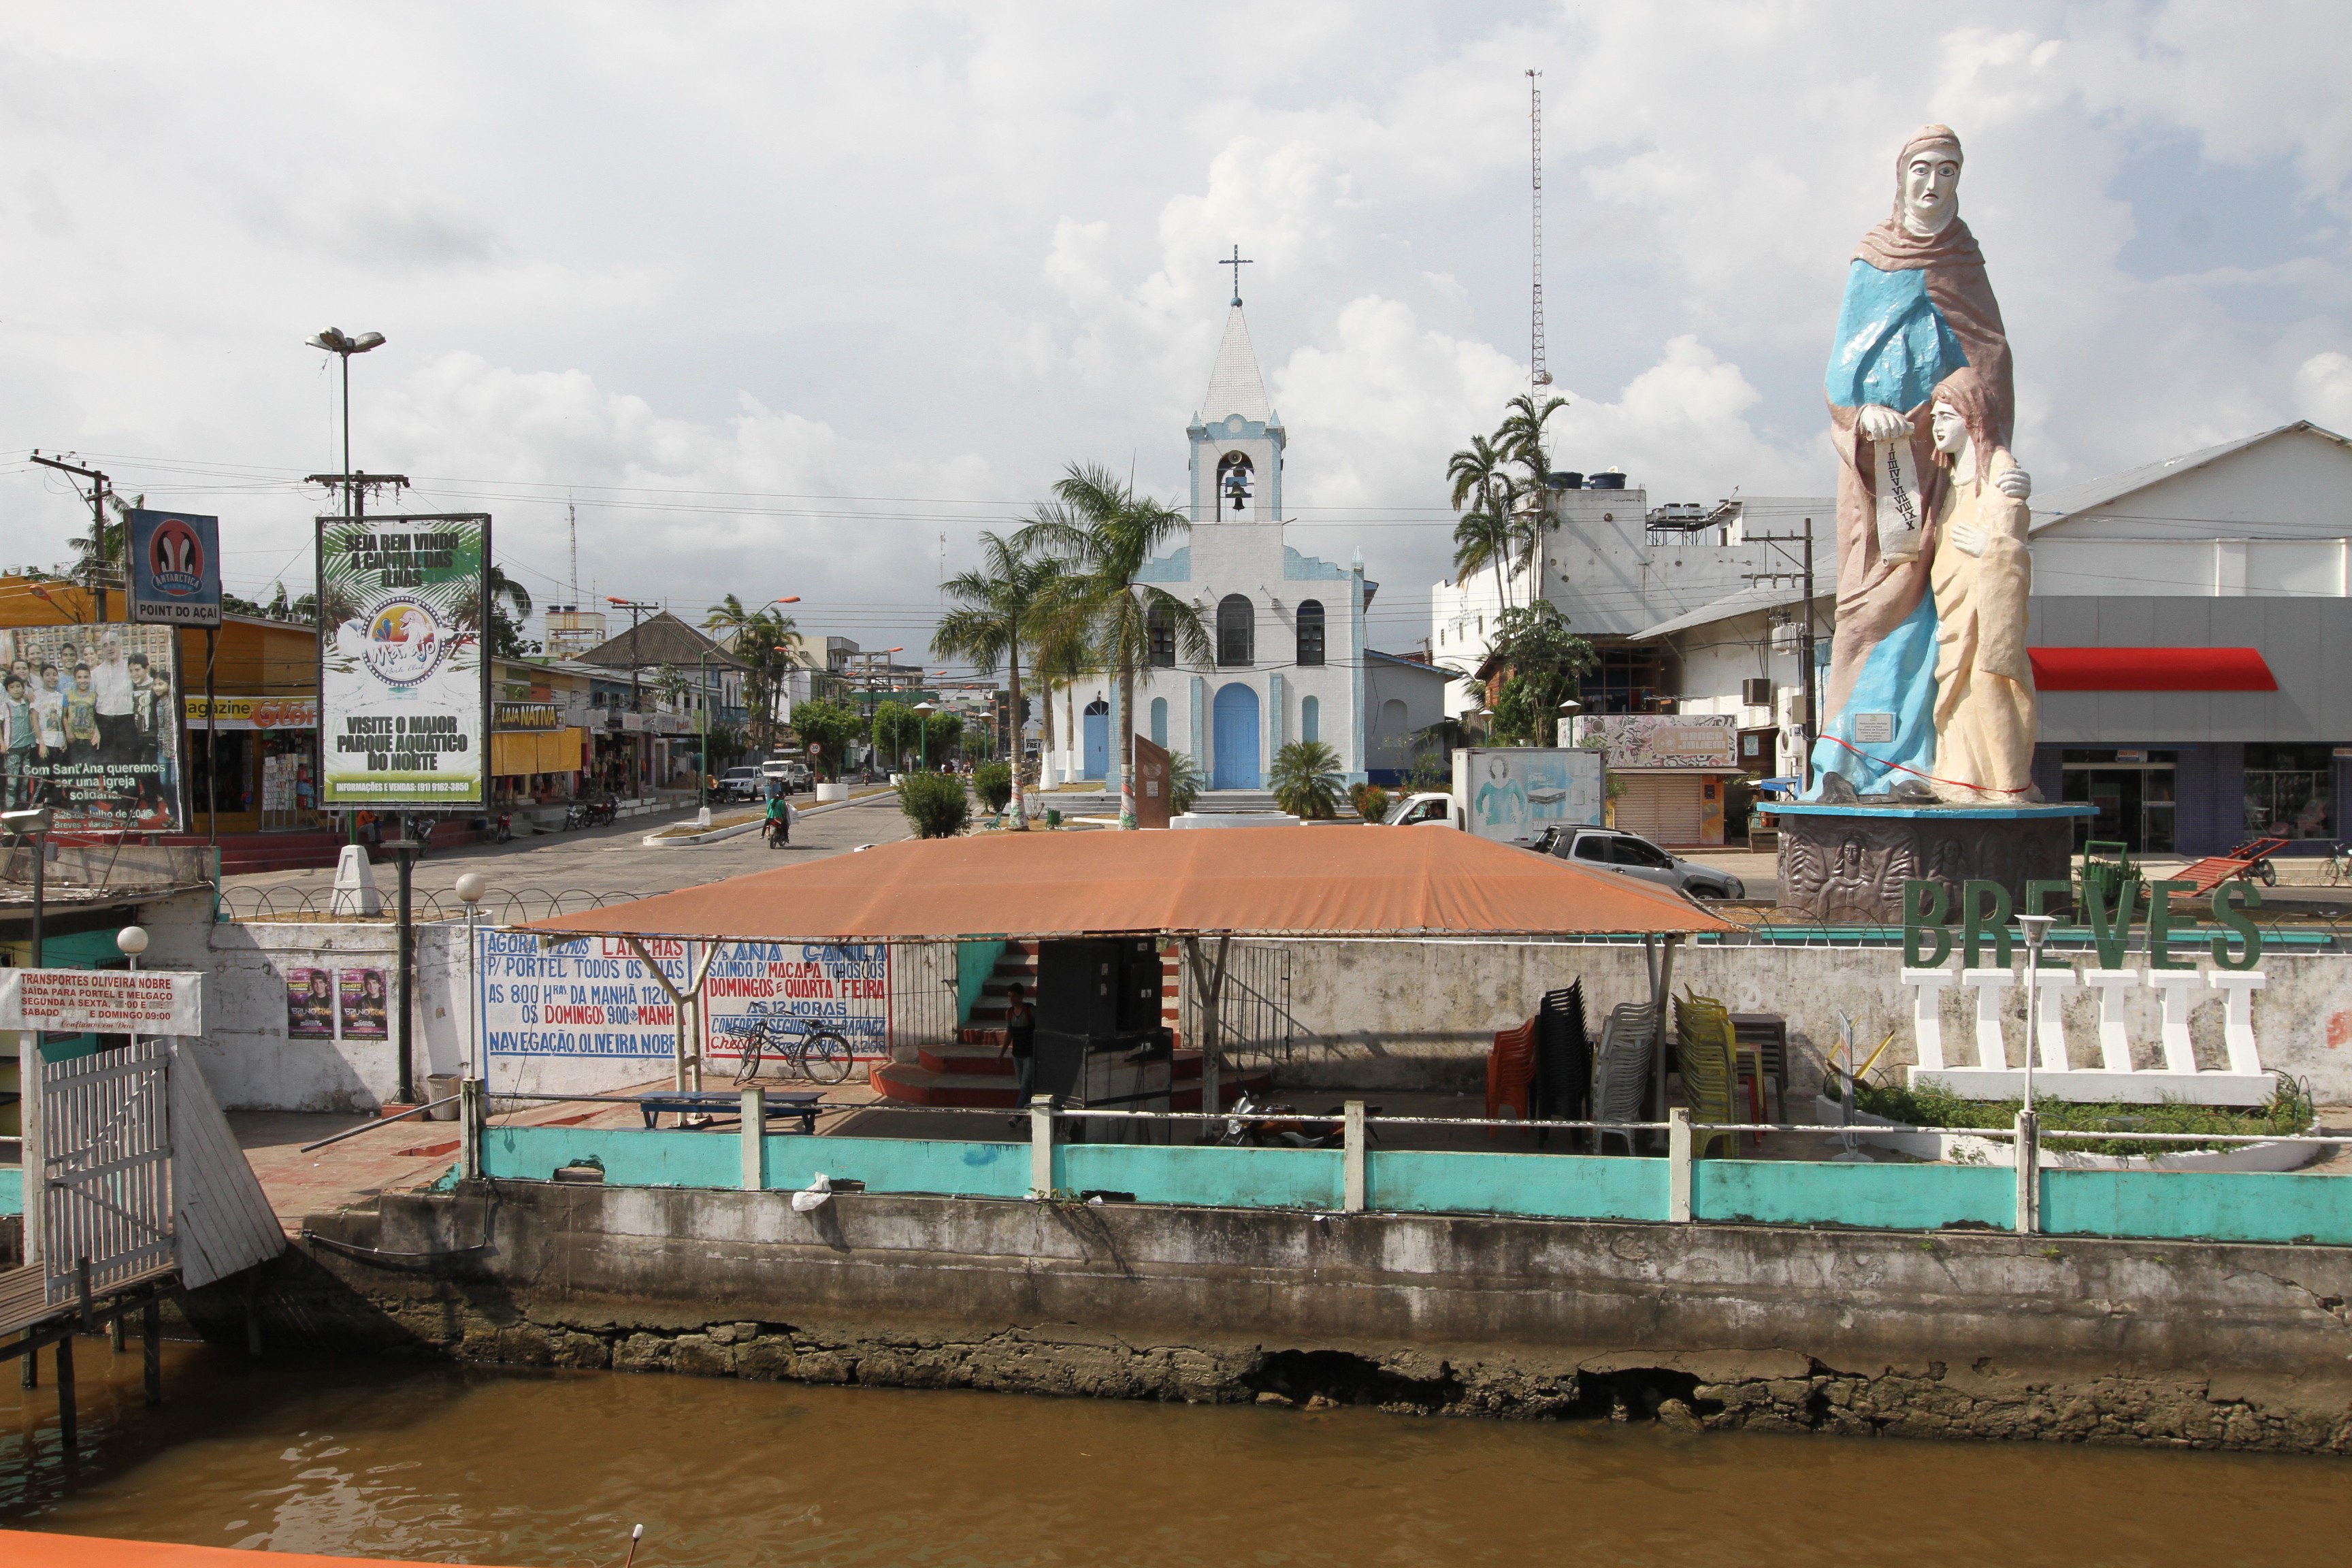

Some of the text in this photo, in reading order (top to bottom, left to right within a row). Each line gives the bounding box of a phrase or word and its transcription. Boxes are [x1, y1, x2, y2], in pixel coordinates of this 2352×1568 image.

[1888, 451, 1895, 460] II
[1888, 460, 1899, 469] III
[1889, 469, 1900, 478] IV
[1891, 478, 1900, 486] V
[1892, 486, 1905, 495] VI
[1894, 493, 1909, 504] VII
[1895, 501, 1913, 513] VIII
[1902, 510, 1916, 521] IX
[1906, 521, 1915, 531] X
[345, 532, 459, 552] SEJA BEM VINDO
[351, 550, 453, 570] A CAPITAL DAS
[156, 573, 199, 589] ANTARCTICA
[382, 570, 423, 587] ILHAS
[140, 604, 217, 620] POINT DO AÇAÍ
[185, 700, 250, 717] agazine
[502, 706, 519, 723] LOJA
[521, 704, 556, 726] NATIVA
[346, 716, 457, 734] VISITE O MAIOR
[338, 733, 468, 753] PARQUE AQUÁTICO
[22, 763, 165, 777] Com Sant'Ana queremos
[368, 753, 438, 771] DO NORTE
[55, 776, 135, 789] ser uma igreja
[336, 782, 469, 794] INFORMAÇÕES E VENDAS: (91) 9162-3850
[115, 808, 127, 818] de
[1904, 879, 2261, 970] BREVES
[488, 933, 538, 953] AGORA
[732, 942, 783, 962] ANA
[802, 945, 888, 962] CAMILA
[488, 957, 501, 977] P/
[506, 958, 567, 978] PORTEL
[574, 959, 620, 979] TODOS
[626, 960, 642, 979] OS
[708, 961, 753, 977] SAINDO
[756, 962, 767, 978] P/
[825, 962, 860, 979] TODOS
[870, 962, 885, 979] OS
[21, 973, 172, 990] TRANSPORTES OLIVEIRA NOBRE
[710, 978, 774, 998] DOMINGOS
[776, 981, 783, 993] E
[785, 979, 834, 998] QUARTA
[842, 979, 885, 999] FEIRA
[21, 986, 48, 996] SAÍDA
[52, 989, 76, 997] PARA
[80, 990, 115, 998] PORTEL
[127, 992, 173, 1002] MELGAÇO
[489, 984, 504, 1003] AS
[571, 985, 587, 1004] DA
[591, 983, 637, 1005] MANHÃ
[21, 998, 66, 1007] SEGUNDA
[78, 999, 111, 1009] SEXTA,
[291, 1007, 316, 1015] BRUNO
[747, 1000, 847, 1015] AS 12 HORAS
[22, 1008, 59, 1017] SABADO
[98, 1011, 143, 1019] DOMINGO
[146, 1011, 171, 1020] 09:00
[344, 1008, 370, 1016] BRUNO
[522, 1004, 538, 1024] OS
[544, 1005, 604, 1025] DOMINGOS
[638, 1006, 686, 1026] MANH
[61, 1020, 101, 1029] Confiamos
[579, 1033, 638, 1054] OLIVEIRA
[642, 1034, 686, 1054] NOBR
